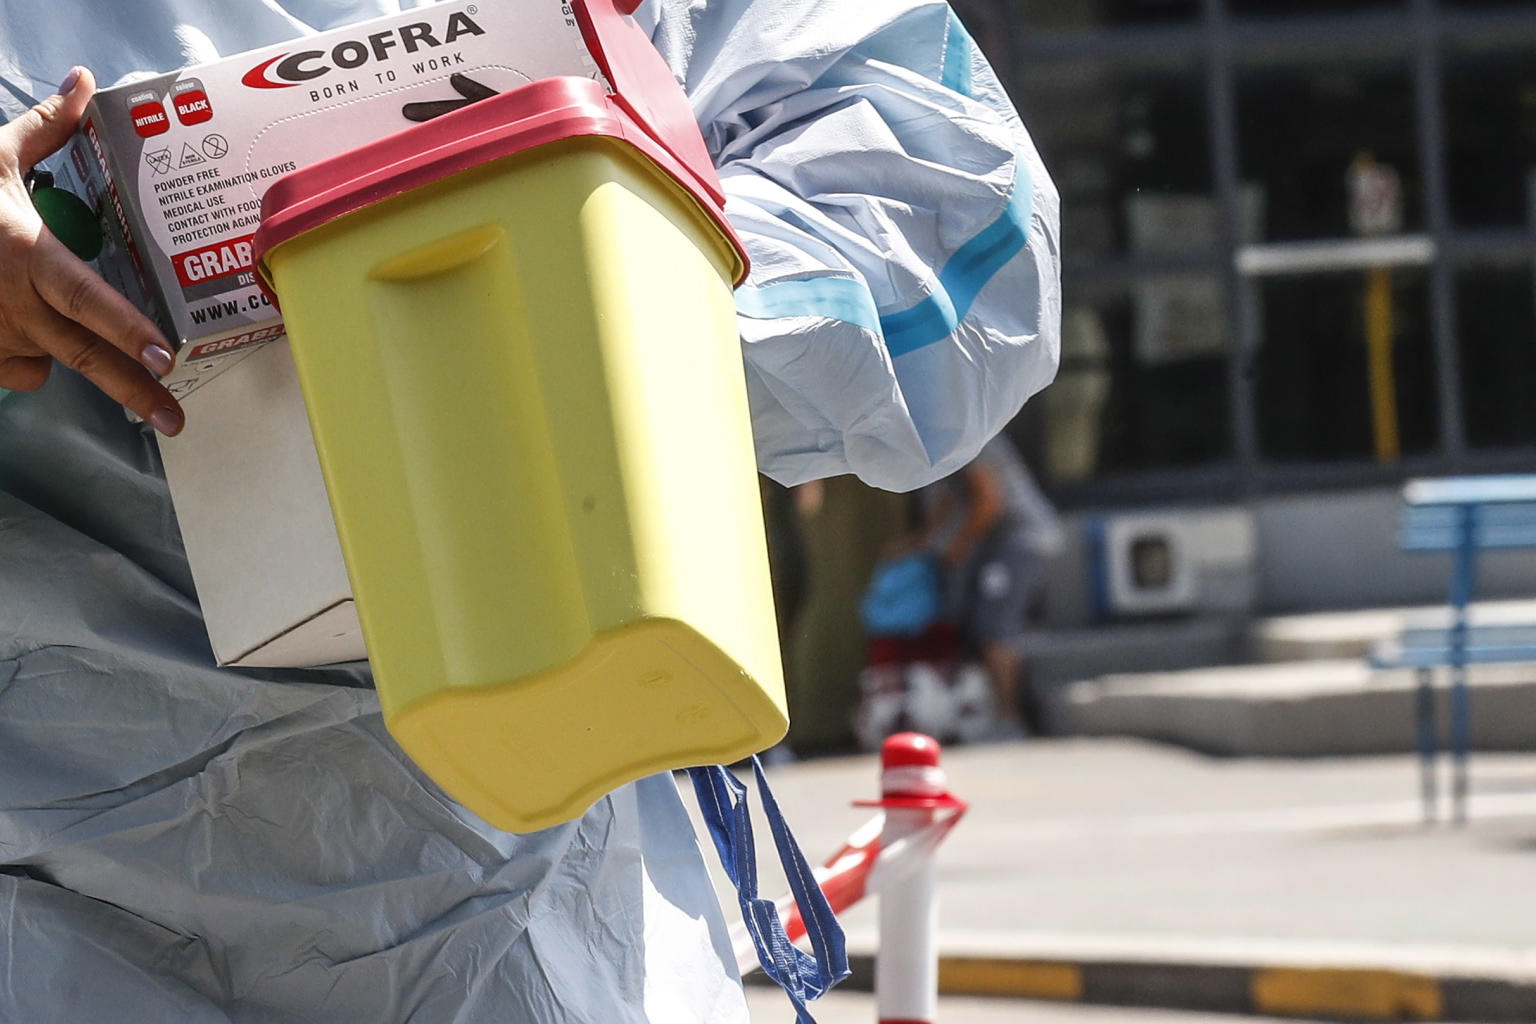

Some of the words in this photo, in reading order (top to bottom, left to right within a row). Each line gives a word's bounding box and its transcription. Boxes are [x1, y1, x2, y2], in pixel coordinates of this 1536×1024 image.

[276, 11, 486, 82] COFRA
[309, 80, 359, 102] BORN
[375, 70, 396, 85] TO
[413, 52, 465, 74] WORK
[135, 112, 165, 127] NITRILE
[178, 99, 208, 115] BLACK
[88, 126, 133, 243] GRABLIGHT
[154, 175, 195, 194] POWDER
[197, 168, 221, 182] FREE
[158, 189, 194, 206] NITRILE
[196, 171, 258, 196] EXAMINATION
[260, 161, 297, 177] GLOVES
[163, 201, 205, 220] MEDICAL
[207, 195, 226, 208] USE
[168, 214, 209, 233] CONTACT
[211, 206, 236, 221] WITH
[172, 222, 230, 246] PROTECTION
[183, 239, 253, 281] GRAB
